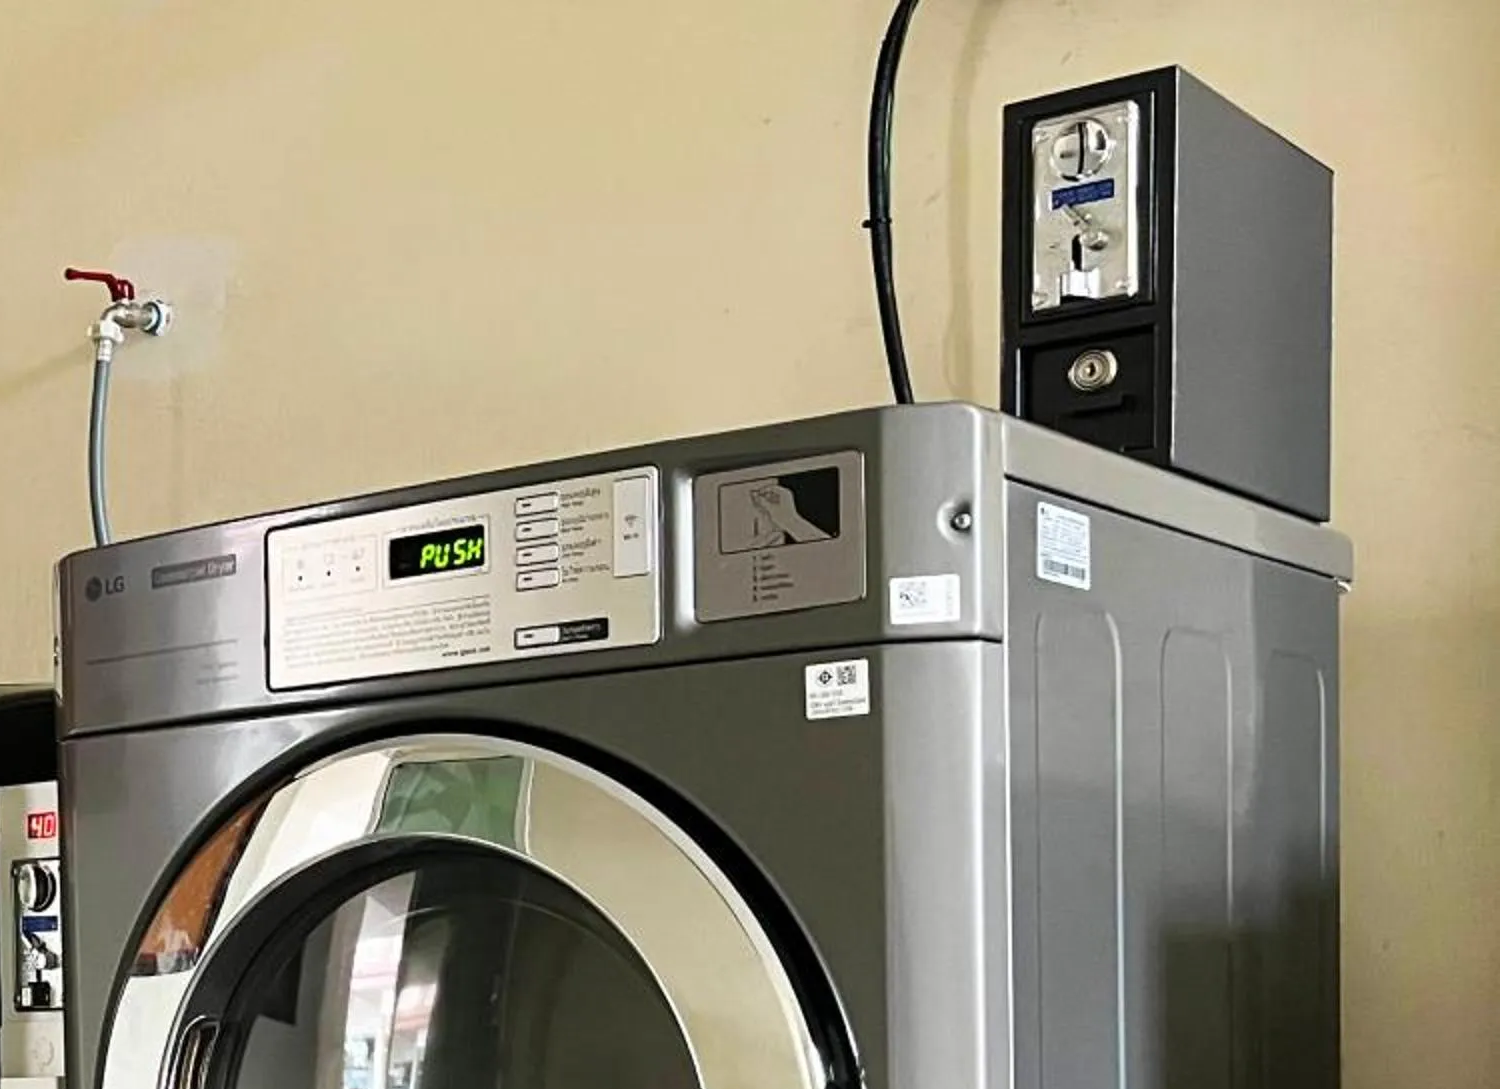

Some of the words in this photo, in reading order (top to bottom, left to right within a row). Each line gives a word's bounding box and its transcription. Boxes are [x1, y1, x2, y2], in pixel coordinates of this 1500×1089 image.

[420, 537, 484, 569] PUSH
[105, 576, 125, 594] LG
[31, 815, 56, 837] 40
